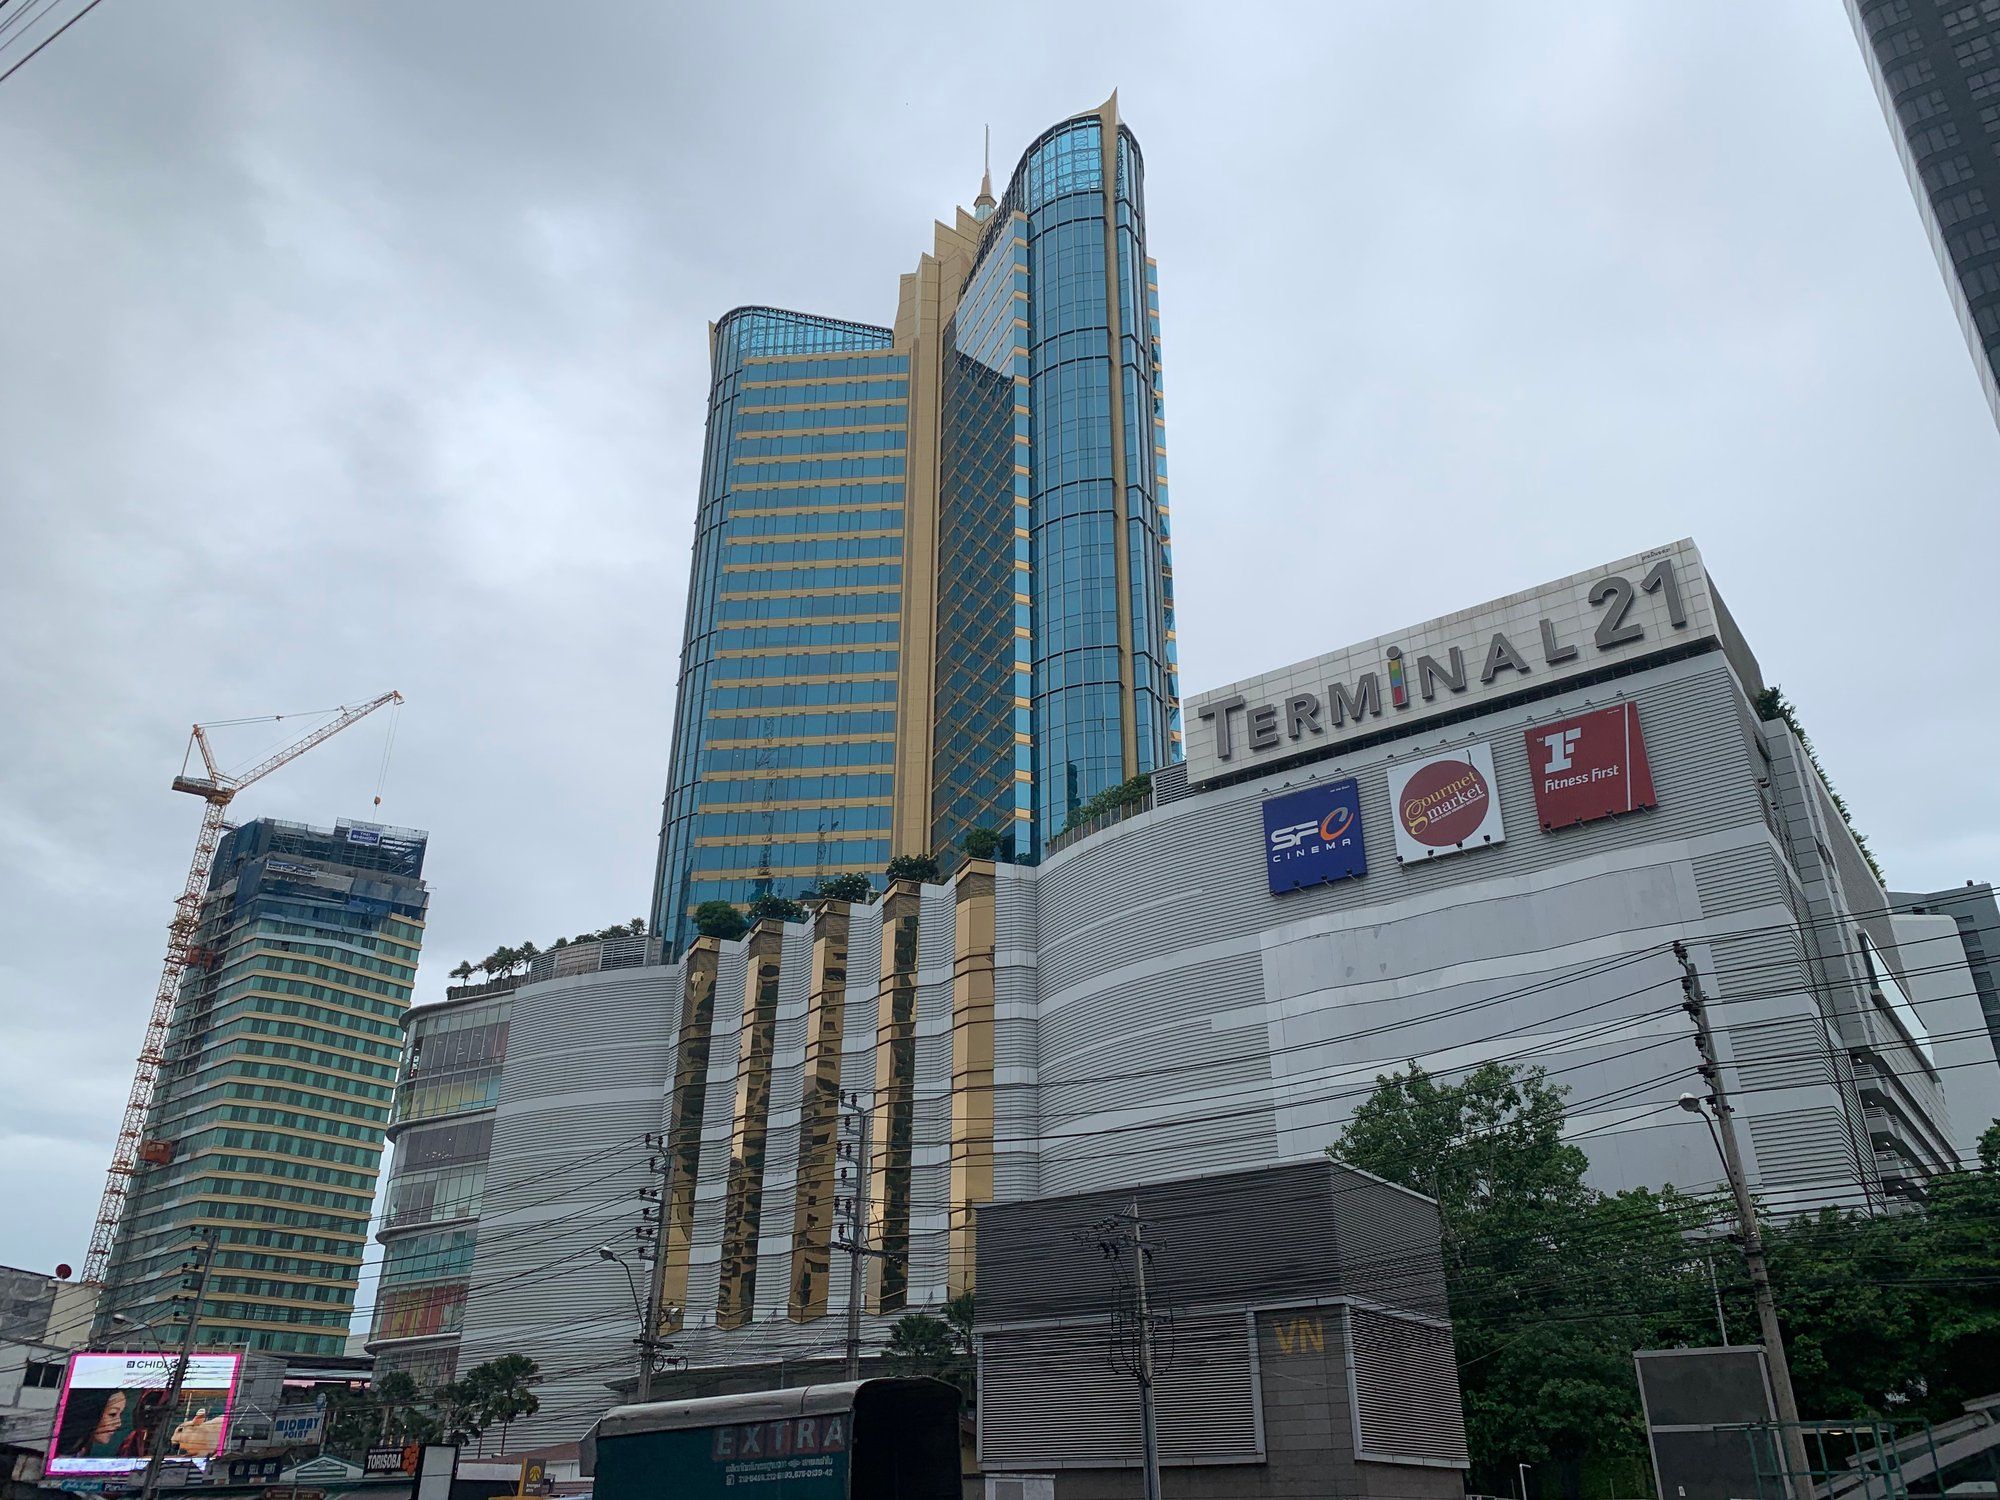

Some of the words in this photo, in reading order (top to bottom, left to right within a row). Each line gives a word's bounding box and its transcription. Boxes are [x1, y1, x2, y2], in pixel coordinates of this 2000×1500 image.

[1588, 559, 1686, 648] 21
[1545, 773, 1589, 794] Fitness
[1592, 764, 1619, 782] First
[1404, 771, 1478, 835] Gourmet
[1427, 783, 1484, 819] market
[1272, 838, 1351, 863] CINEMA
[136, 1360, 183, 1369] CHIDLO
[717, 1417, 845, 1455] EXTRA
[367, 1453, 402, 1469] TORISOBA
